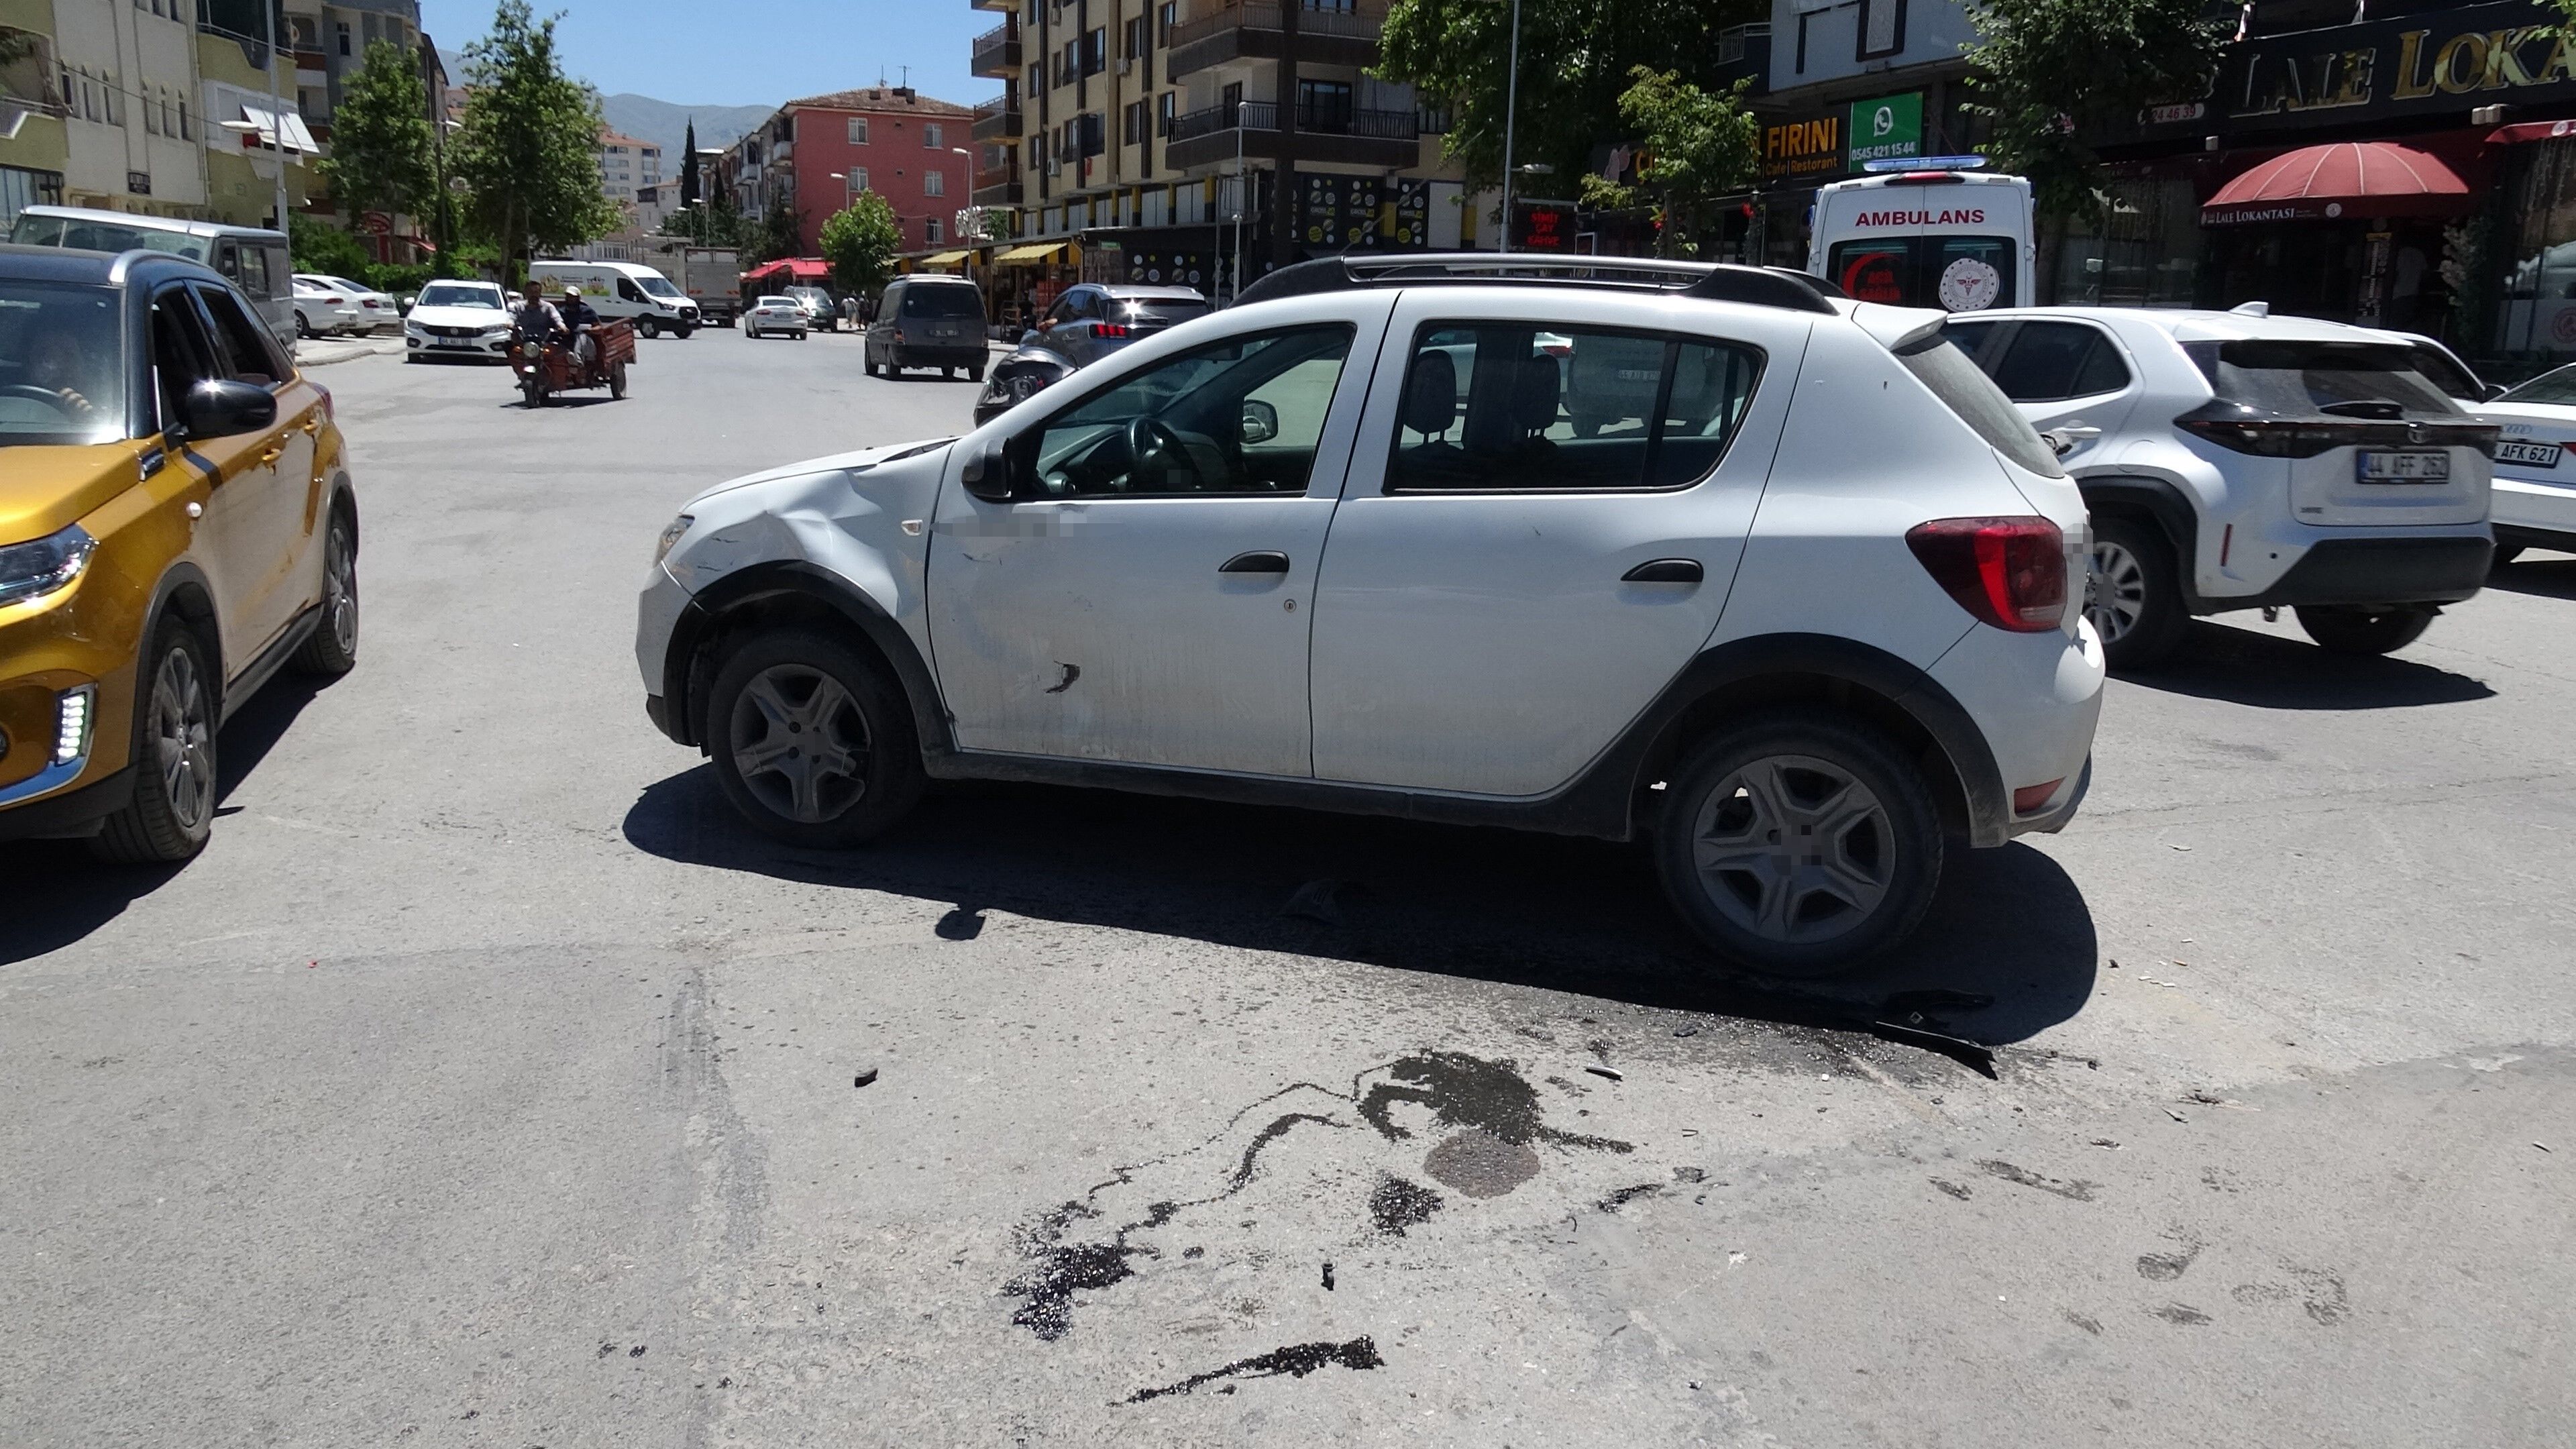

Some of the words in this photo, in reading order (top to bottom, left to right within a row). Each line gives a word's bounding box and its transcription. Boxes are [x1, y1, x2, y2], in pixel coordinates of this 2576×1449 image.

[1767, 117, 1838, 159] FIRINI
[1851, 147, 1873, 161] 0545
[1873, 145, 1890, 158] 421
[1891, 142, 1902, 155] 15
[1902, 141, 1917, 154] 44
[1790, 156, 1838, 172] Restorant
[1855, 209, 1985, 227] AMBULANS
[2216, 211, 2233, 224] LALE
[2236, 207, 2295, 222] LOKANTASI
[2501, 444, 2527, 459] AFK
[2528, 447, 2554, 462] 621
